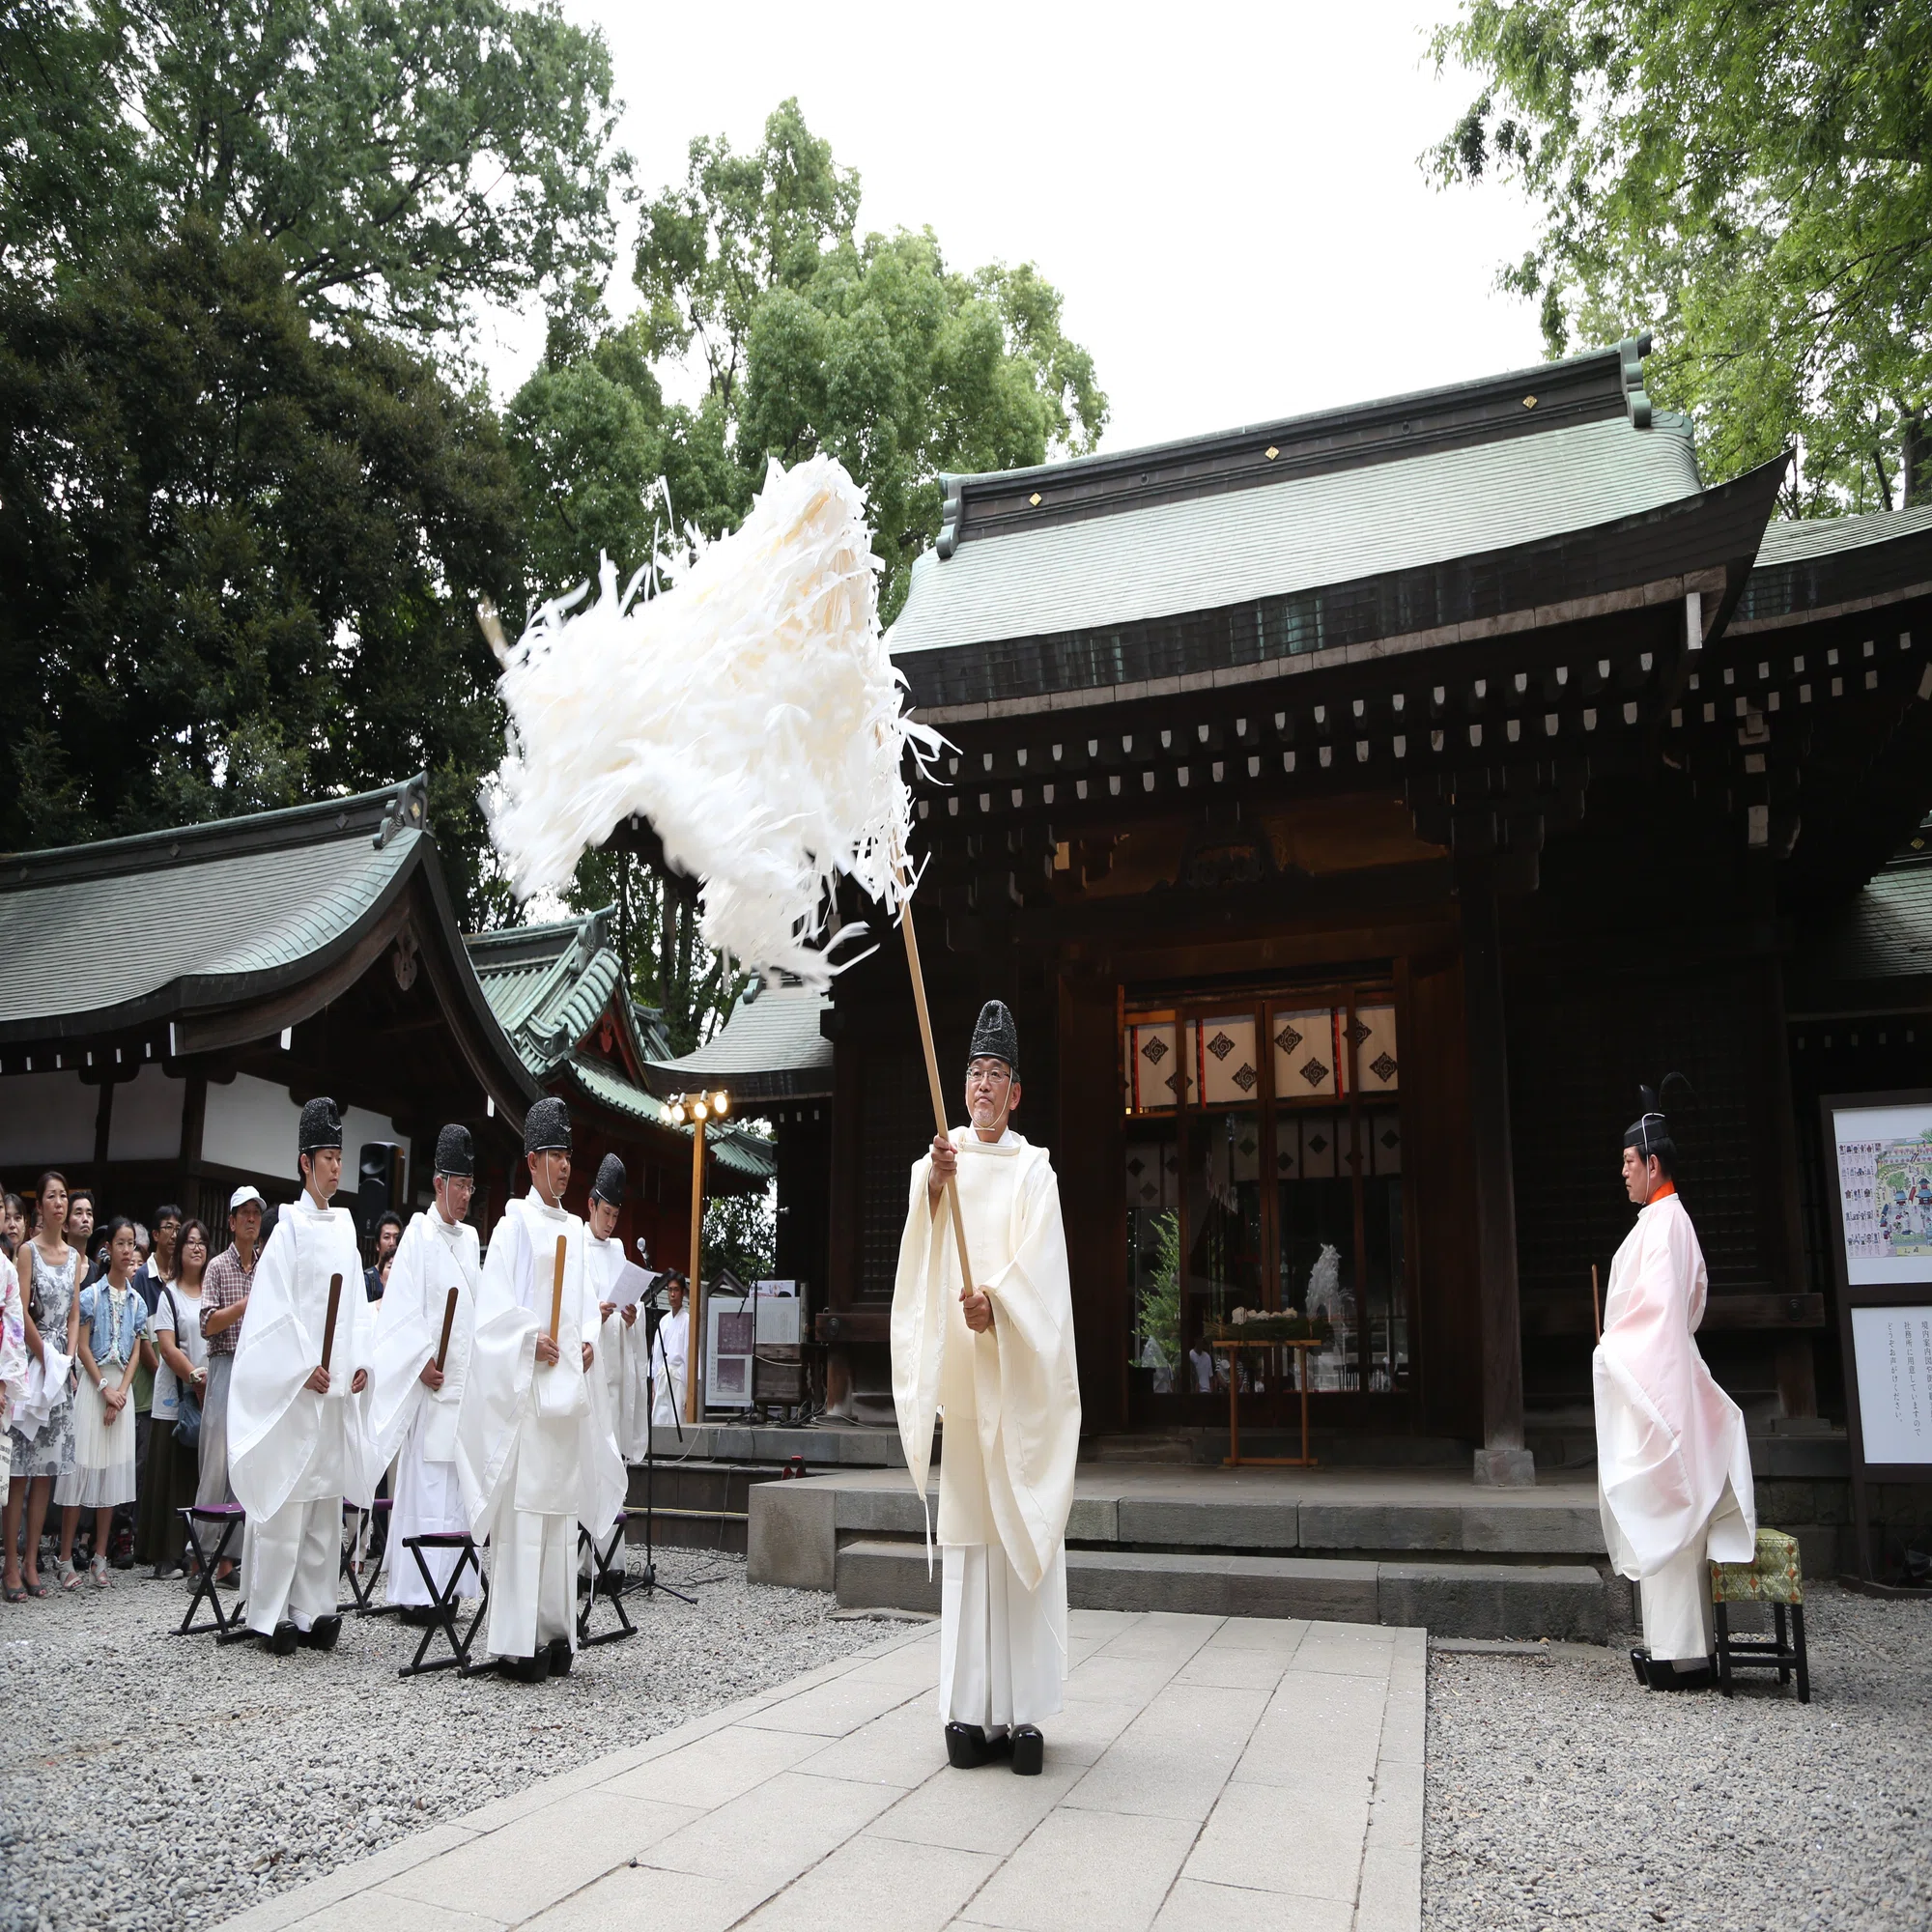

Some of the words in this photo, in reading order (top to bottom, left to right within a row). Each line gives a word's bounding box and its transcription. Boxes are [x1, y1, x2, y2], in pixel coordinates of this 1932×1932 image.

[1888, 1321, 1903, 1422] どうぞお声がけください。
[1904, 1321, 1921, 1436] 社務所に用意していますので
